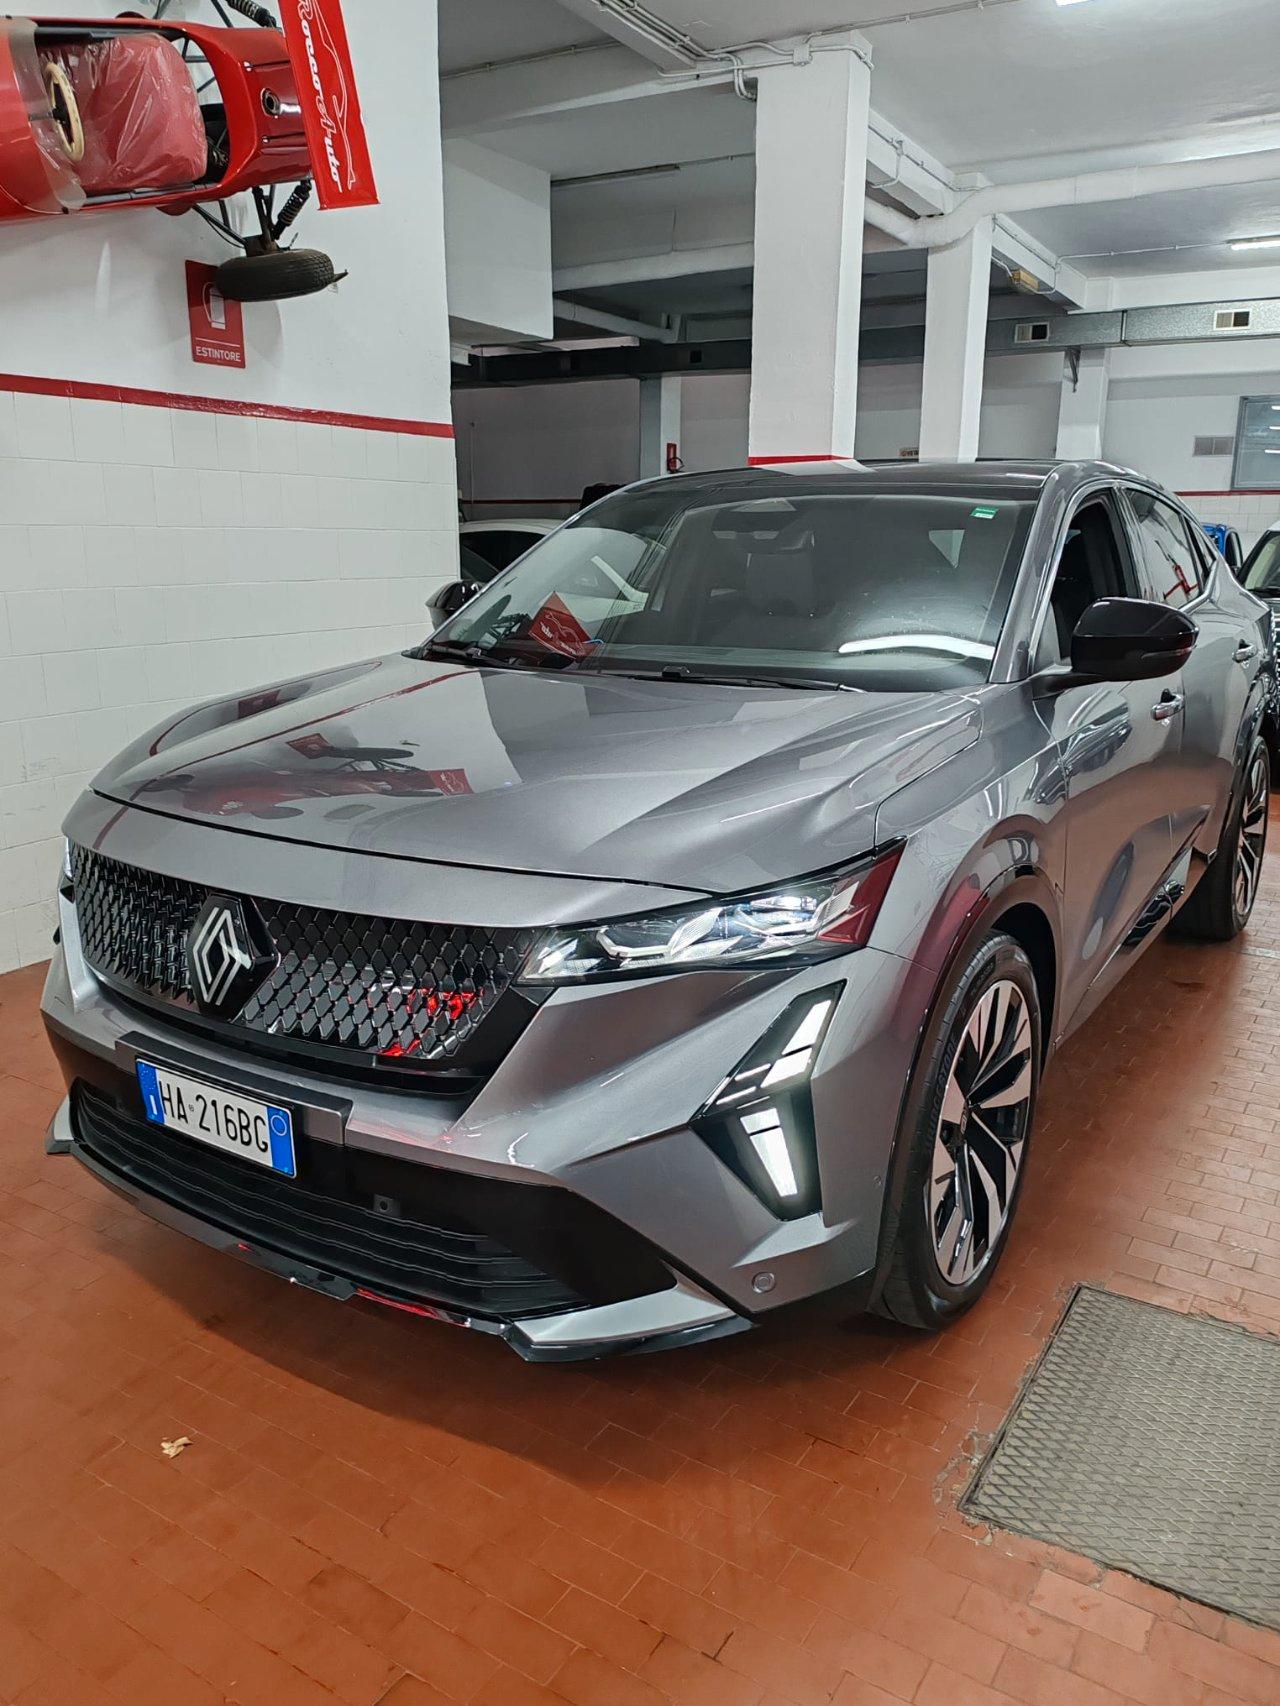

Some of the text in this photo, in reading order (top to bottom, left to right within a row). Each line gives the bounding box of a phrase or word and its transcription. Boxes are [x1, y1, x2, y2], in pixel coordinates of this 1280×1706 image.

[195, 346, 241, 362] ESTINTORE
[158, 1080, 269, 1153] HA 216BG
